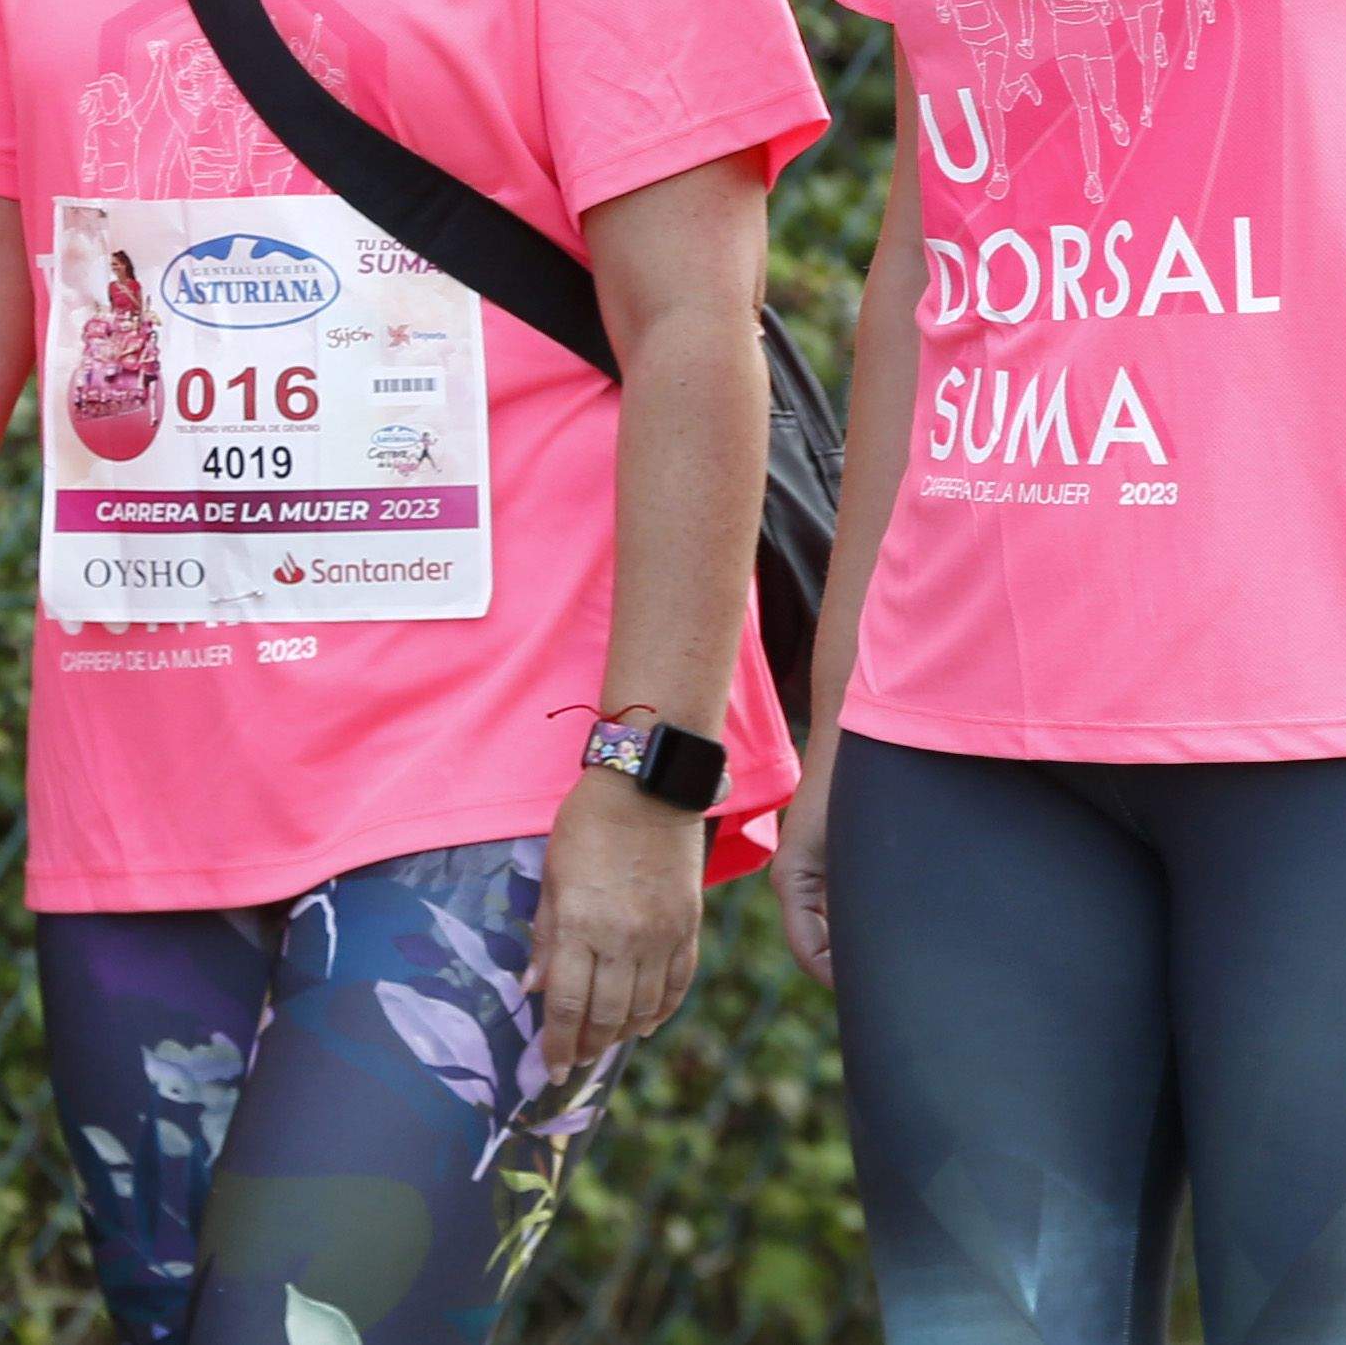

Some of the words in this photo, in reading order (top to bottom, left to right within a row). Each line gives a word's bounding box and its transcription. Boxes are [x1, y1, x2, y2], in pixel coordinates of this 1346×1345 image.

[919, 87, 990, 183] U
[355, 239, 376, 251] TU
[174, 269, 326, 304] ASTURIANA
[192, 266, 254, 276] CENTRAL
[258, 265, 317, 275] LECHERA
[925, 215, 1280, 326] DORSAL
[176, 366, 319, 422] 016
[930, 366, 1169, 468] SUMA
[202, 446, 293, 479] 4019
[96, 502, 198, 523] CARRERA
[204, 502, 235, 523] DE
[240, 502, 273, 523] LA
[278, 500, 369, 522] MUJER
[379, 498, 441, 521] 2023
[1018, 483, 1090, 504] MUJER
[1119, 482, 1178, 505] 2023
[84, 558, 205, 589] OYSHO
[311, 557, 453, 586] Santander
[126, 651, 145, 671] DE
[148, 651, 167, 671] LA
[171, 645, 233, 668] MUJER
[256, 636, 318, 664] 2023
